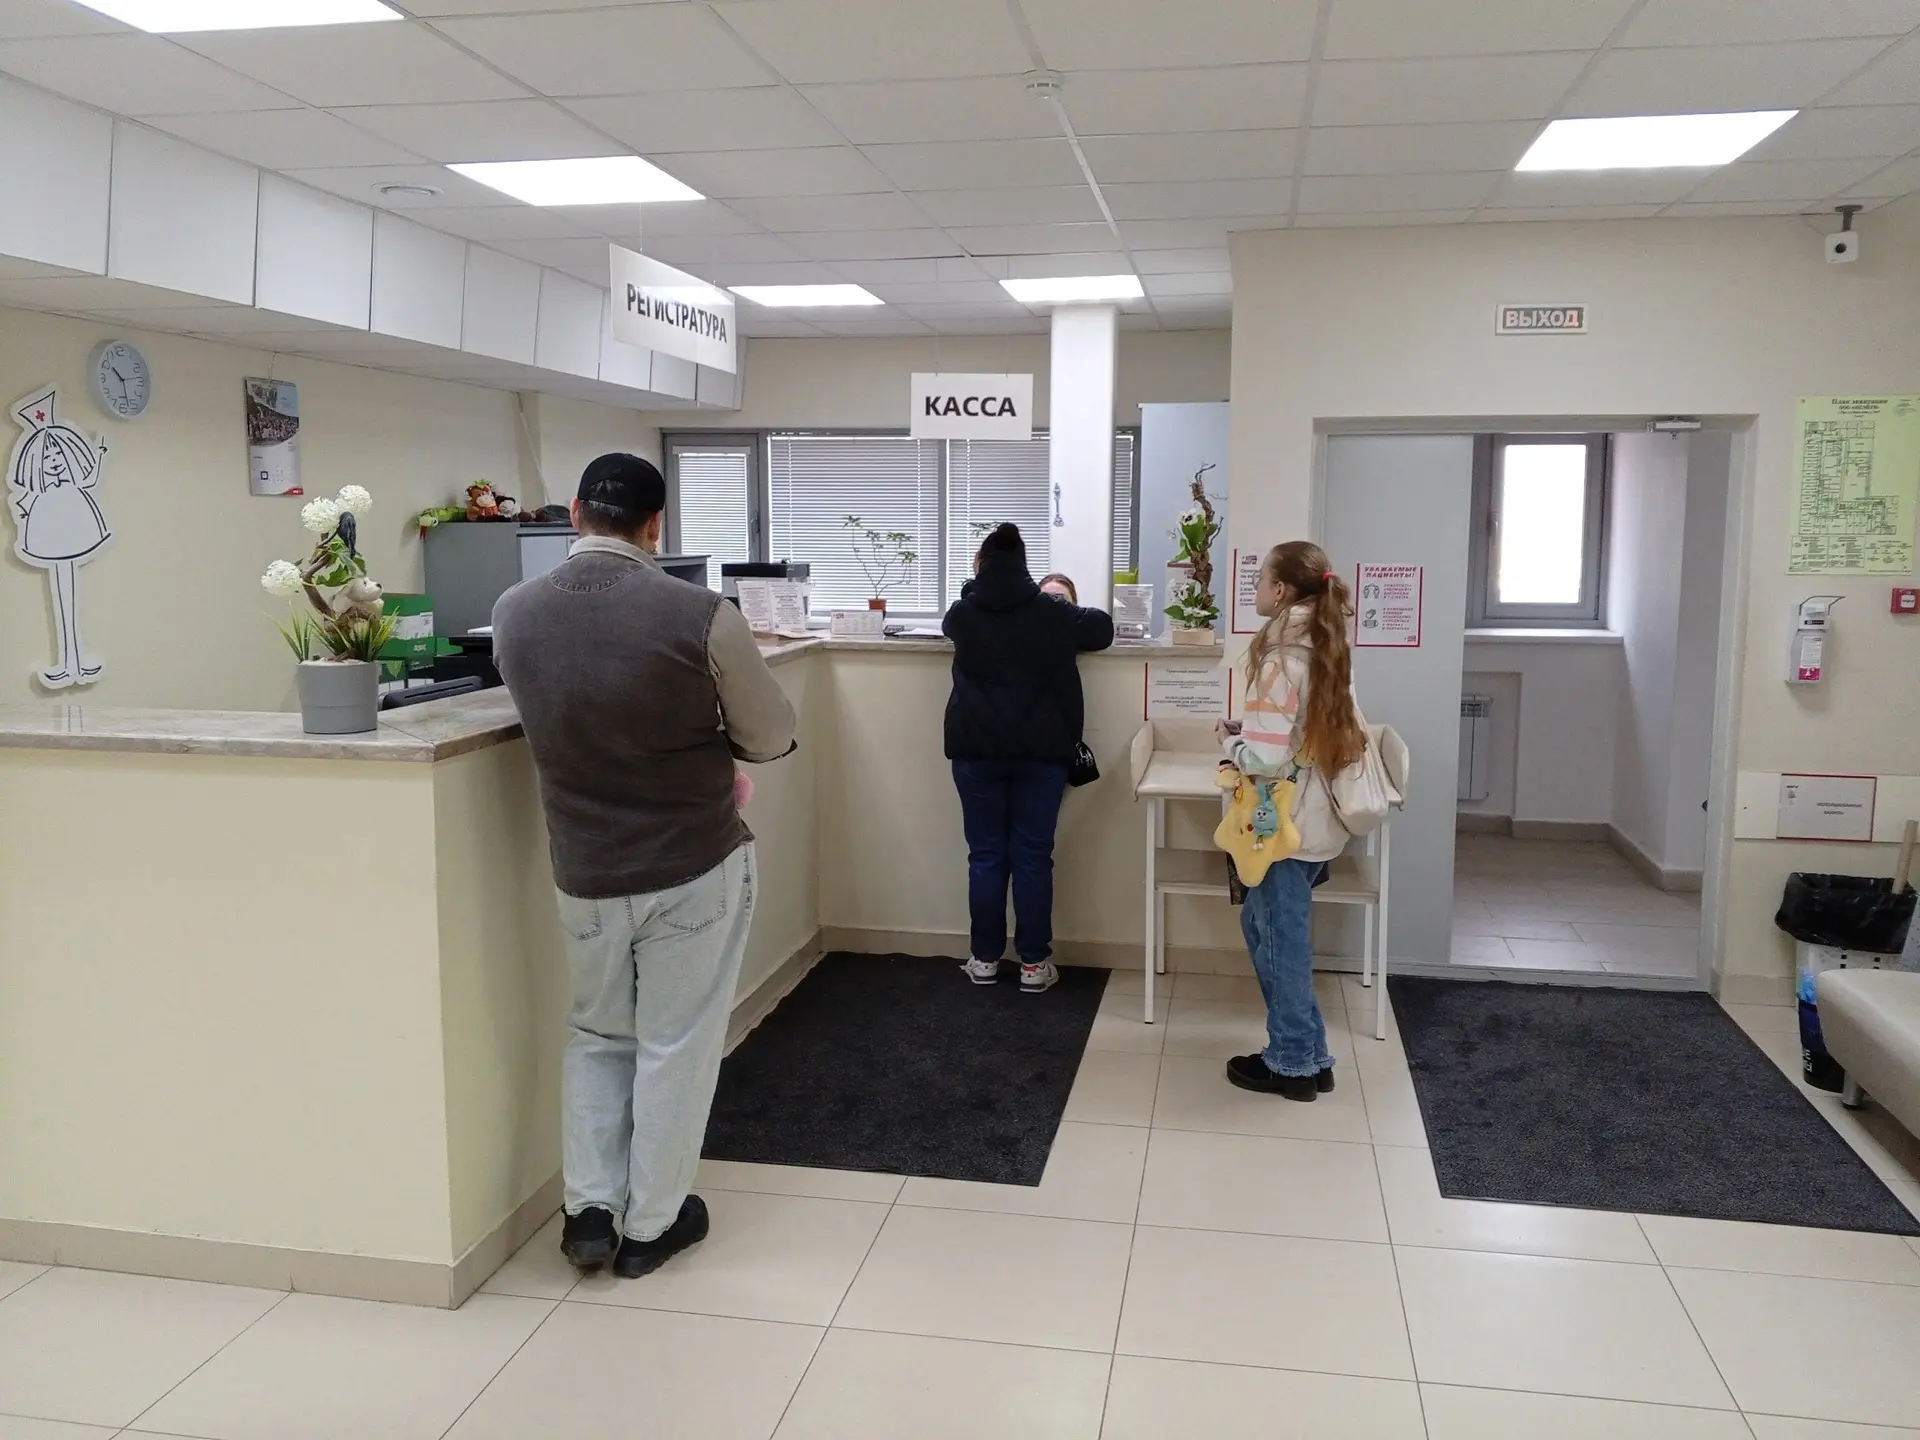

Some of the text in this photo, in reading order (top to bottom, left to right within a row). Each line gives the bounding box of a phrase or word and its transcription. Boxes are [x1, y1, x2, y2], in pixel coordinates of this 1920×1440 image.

[627, 282, 728, 344] РЕГИСТРАТУРА
[1505, 309, 1580, 328] ВЫХОД
[925, 396, 1017, 417] КАССА
